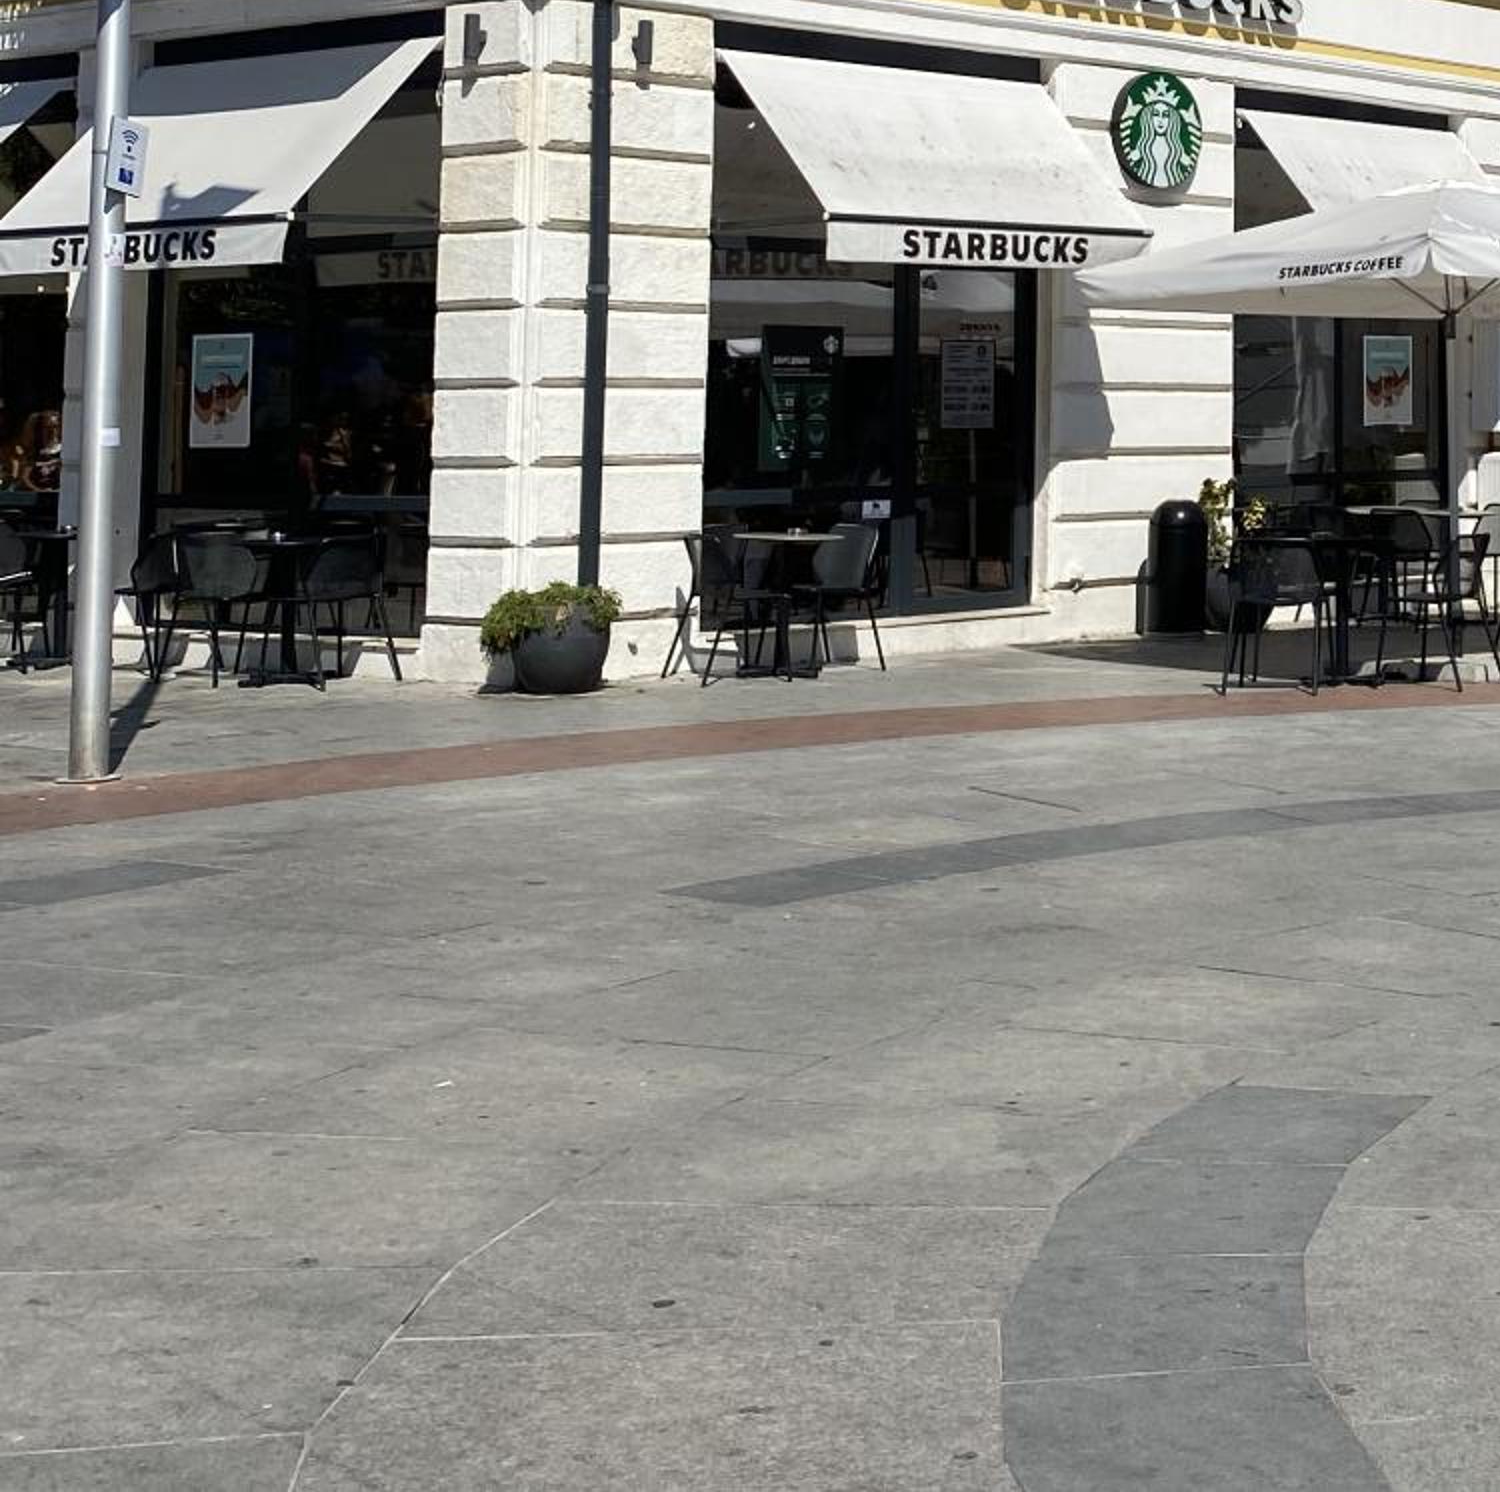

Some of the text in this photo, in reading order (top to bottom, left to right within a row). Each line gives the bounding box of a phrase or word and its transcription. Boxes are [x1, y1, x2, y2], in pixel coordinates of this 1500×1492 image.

[51, 230, 216, 267] STBUCKS
[903, 229, 1089, 264] STARBUCKS
[378, 251, 436, 279] STA
[1279, 261, 1353, 280] STARBUCKS
